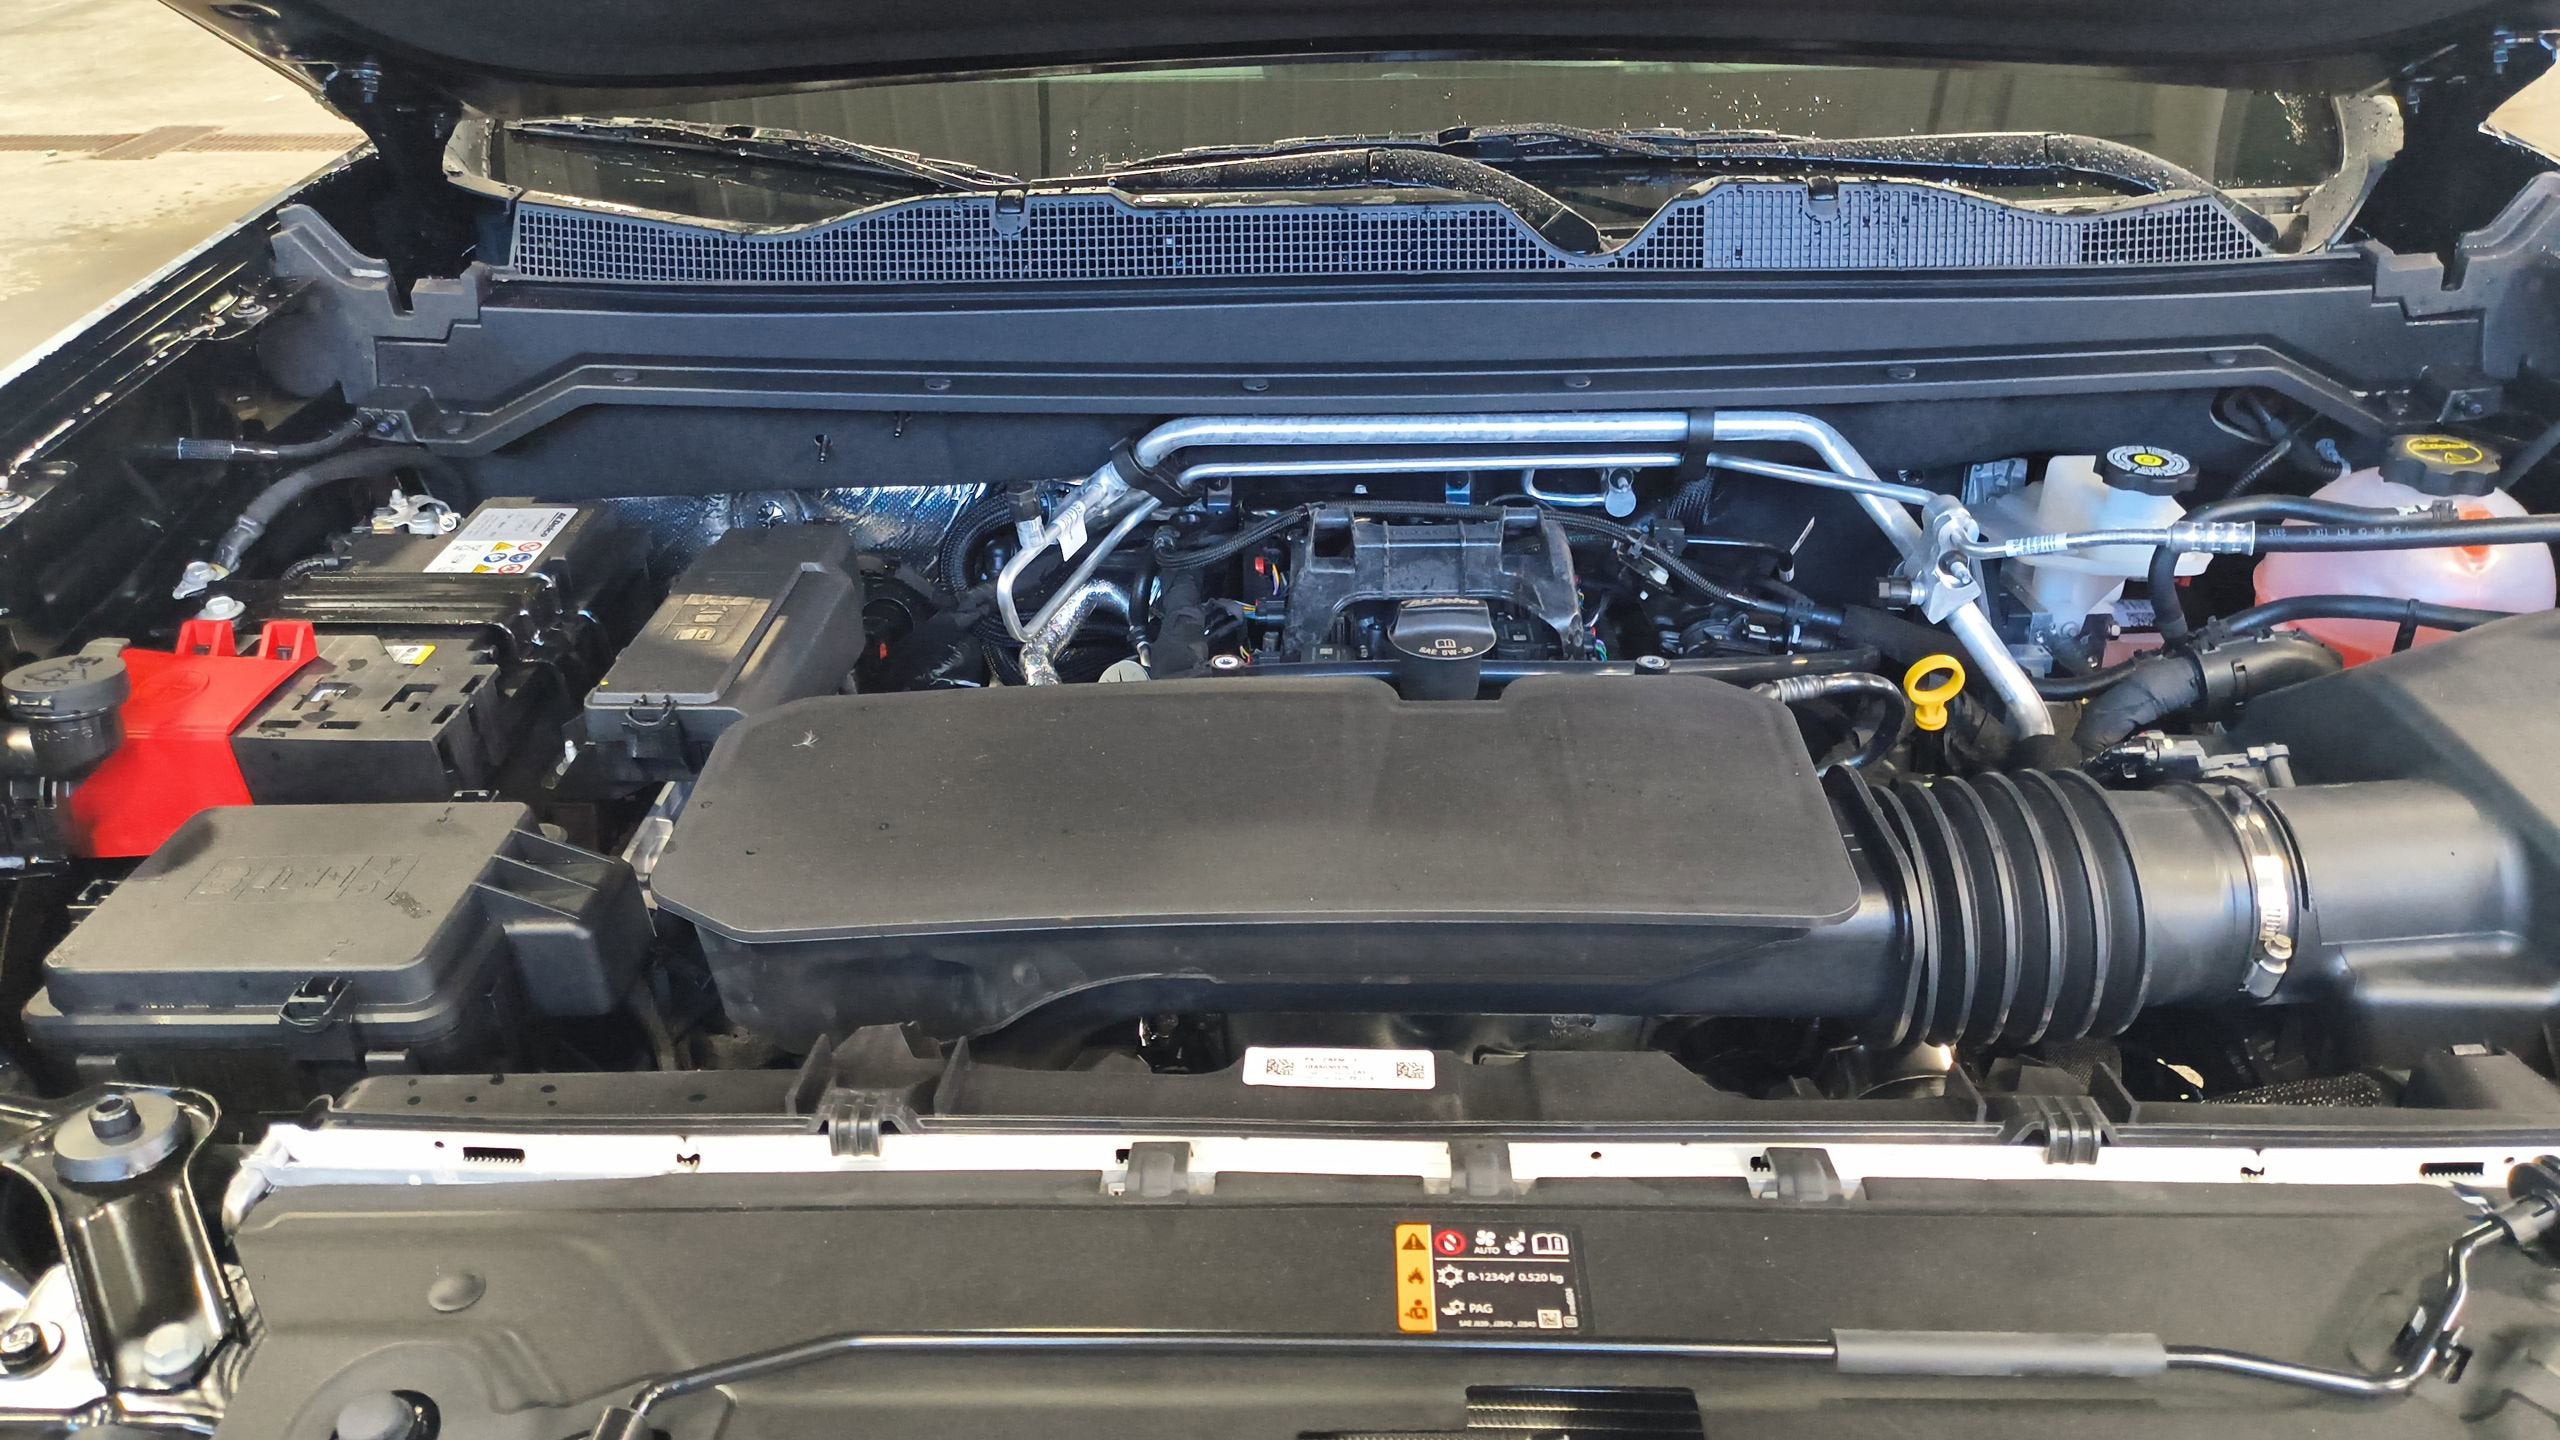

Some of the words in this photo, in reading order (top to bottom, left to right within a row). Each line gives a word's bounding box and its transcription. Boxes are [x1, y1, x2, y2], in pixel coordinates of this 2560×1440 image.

[1402, 598, 1479, 608] ACDelco
[1418, 646, 1437, 655] SAE
[1474, 1247, 1500, 1255] AUTO
[1467, 1272, 1515, 1283] R-1234yf
[1518, 1272, 1549, 1283] 0.520
[1549, 1272, 1564, 1284] kg
[1469, 1304, 1493, 1313] PAG
